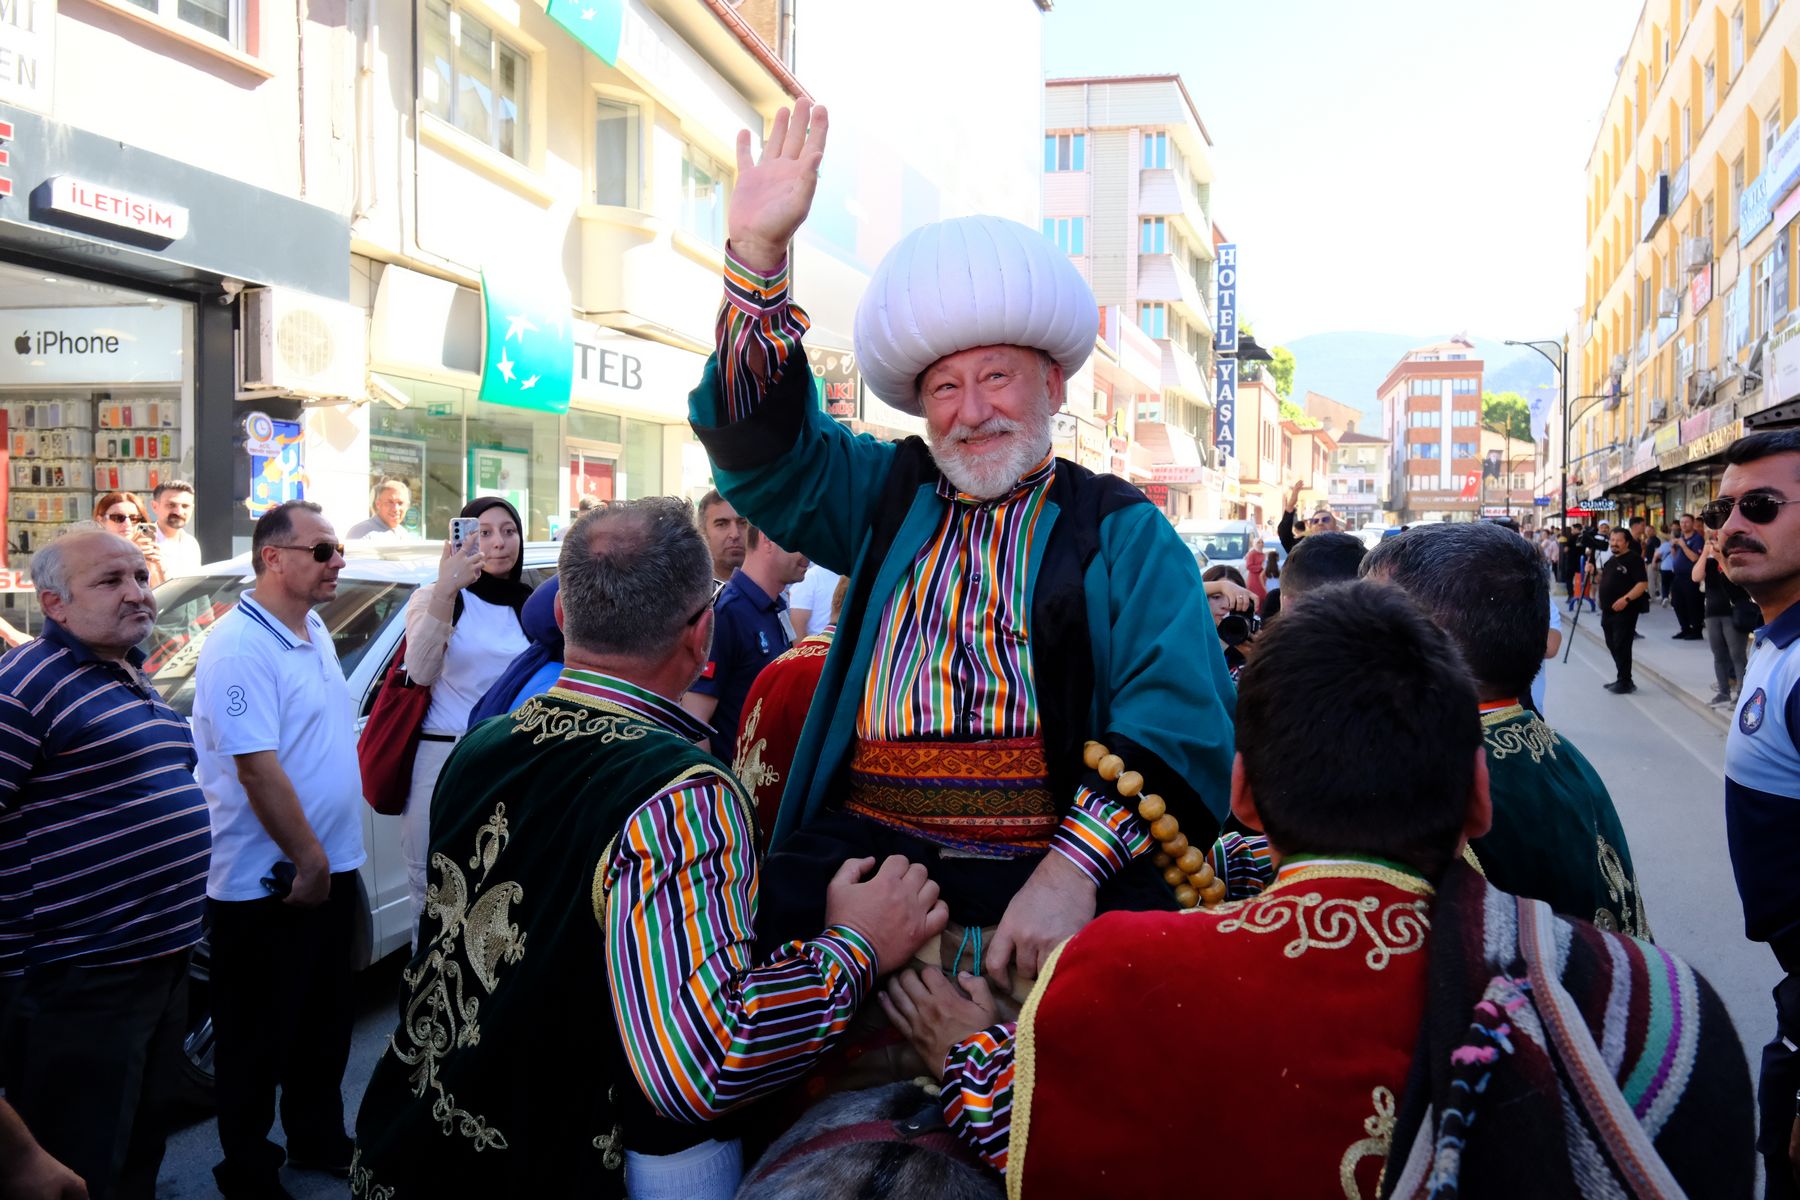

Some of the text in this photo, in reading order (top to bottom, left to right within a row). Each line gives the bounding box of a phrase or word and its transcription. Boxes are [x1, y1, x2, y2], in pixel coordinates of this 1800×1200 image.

[71, 182, 172, 229] İLETİŞİM
[1219, 247, 1235, 347] HOTEL
[36, 330, 119, 355] iPhone
[574, 342, 643, 390] TEB
[1218, 363, 1234, 465] YAŞAR
[226, 685, 248, 717] 3
